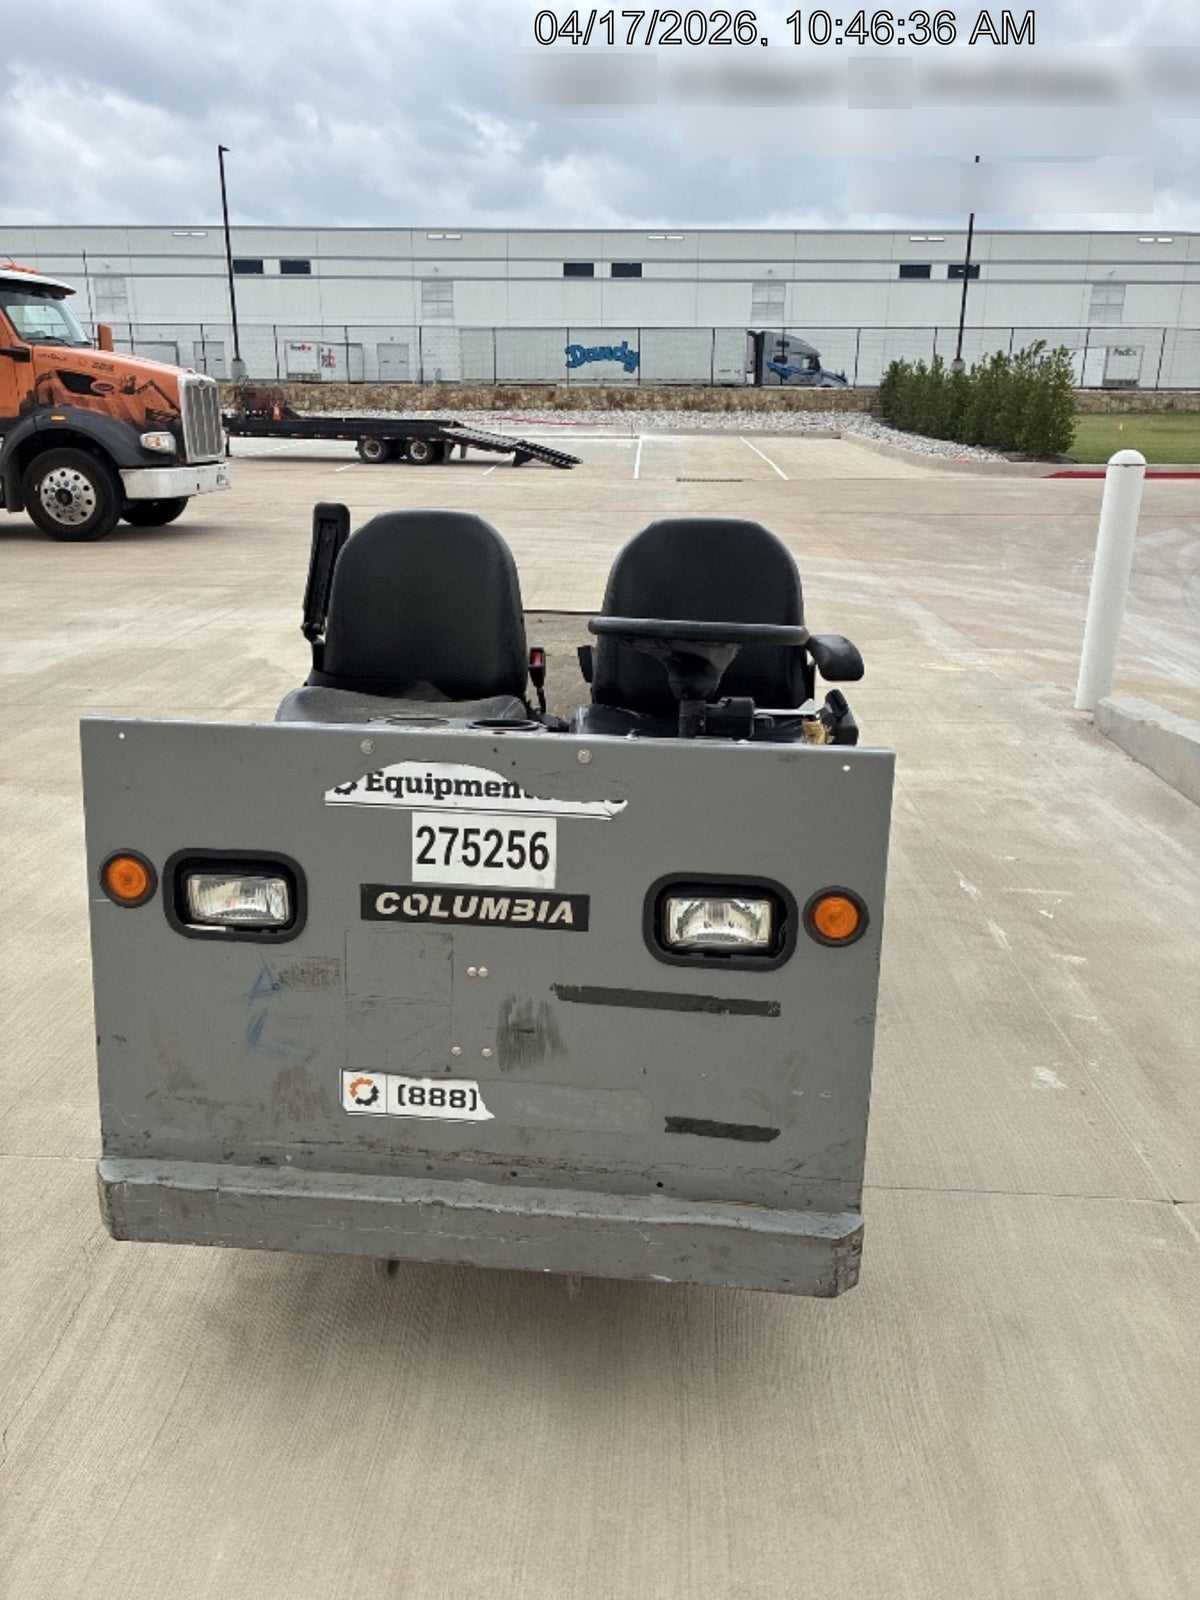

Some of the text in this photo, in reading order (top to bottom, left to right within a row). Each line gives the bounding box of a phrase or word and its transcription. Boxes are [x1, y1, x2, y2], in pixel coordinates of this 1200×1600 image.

[365, 771, 535, 800] Equipmen
[415, 826, 549, 871] 275256
[375, 892, 574, 924] COLUMBIA
[398, 1084, 477, 1112] (888)
